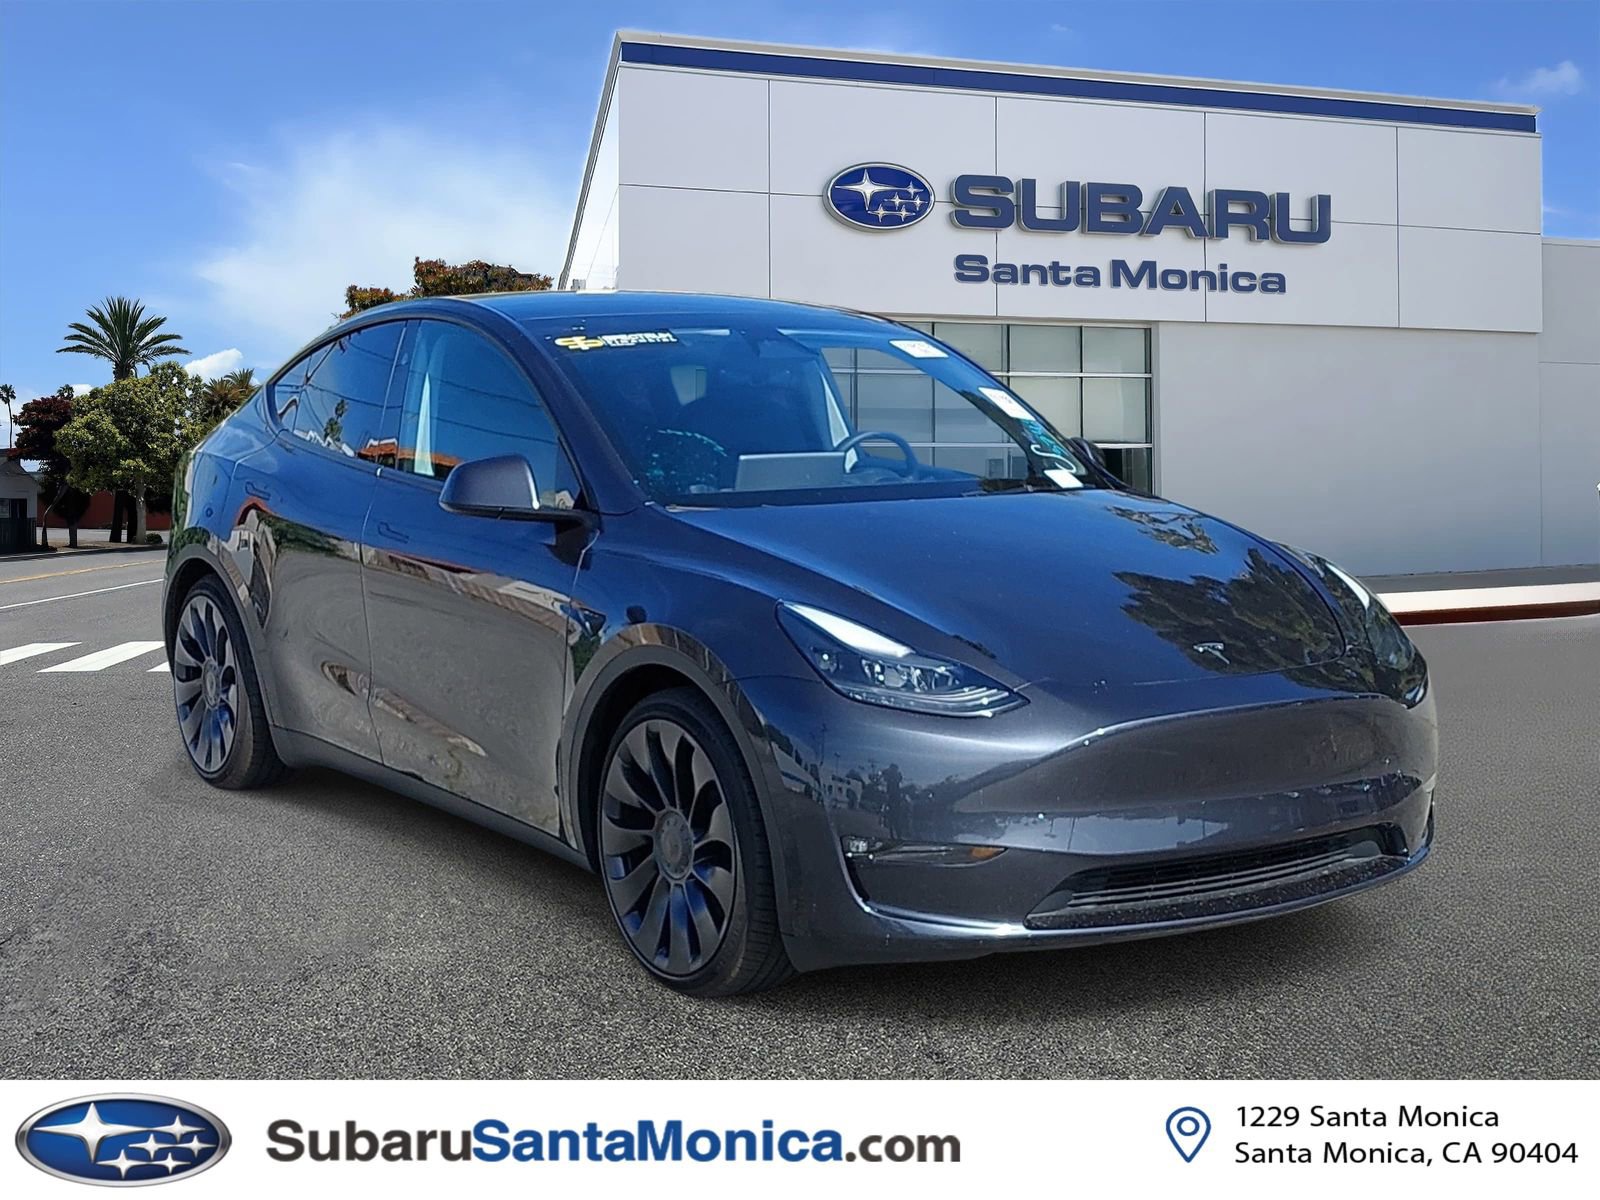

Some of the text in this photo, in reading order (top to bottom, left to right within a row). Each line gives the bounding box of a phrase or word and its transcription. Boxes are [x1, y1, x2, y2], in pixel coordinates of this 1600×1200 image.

[951, 174, 1332, 245] SUBARU
[954, 253, 1288, 295] Santa Monica
